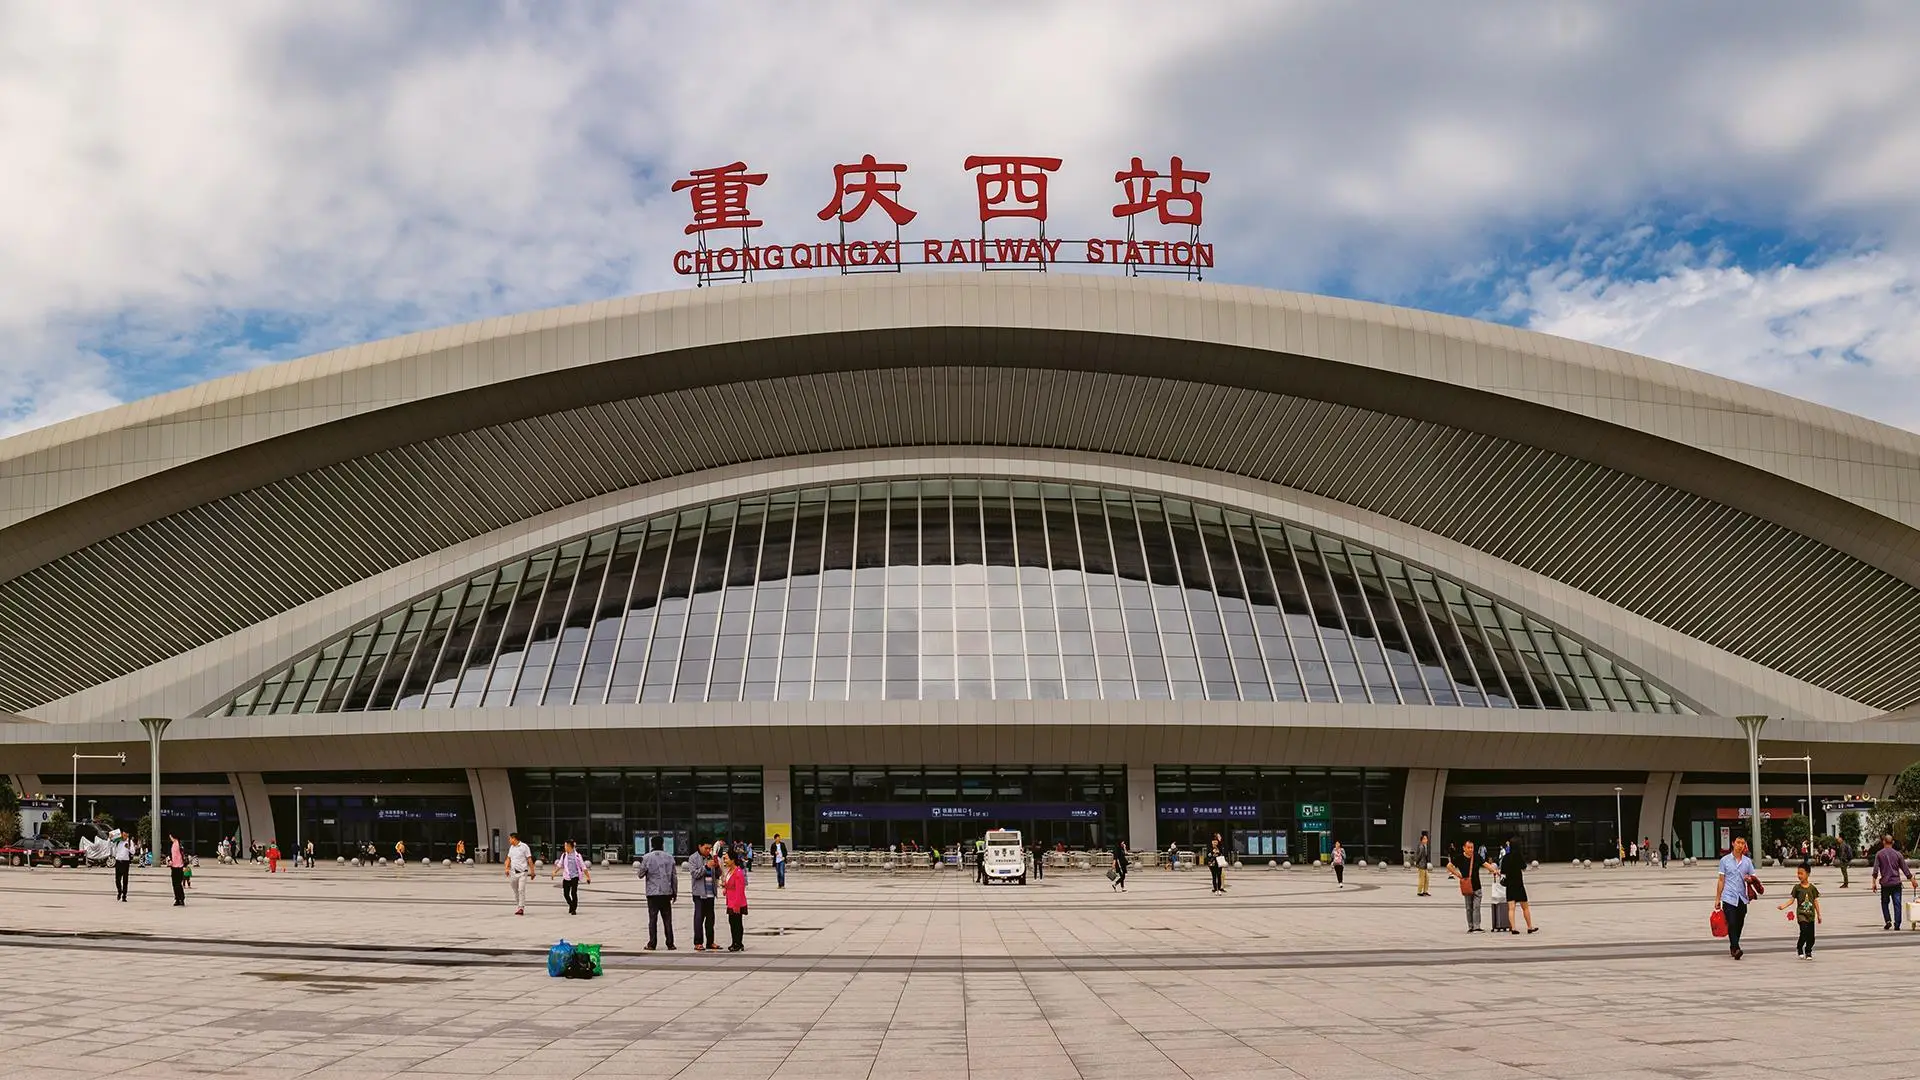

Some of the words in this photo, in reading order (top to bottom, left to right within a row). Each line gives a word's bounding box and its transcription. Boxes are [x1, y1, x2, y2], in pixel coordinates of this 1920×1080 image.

[672, 155, 1211, 234] 重庆西站
[673, 239, 900, 274] CHONGQINGXI
[924, 239, 1062, 265] RAILWAY
[1087, 239, 1214, 267] STATION
